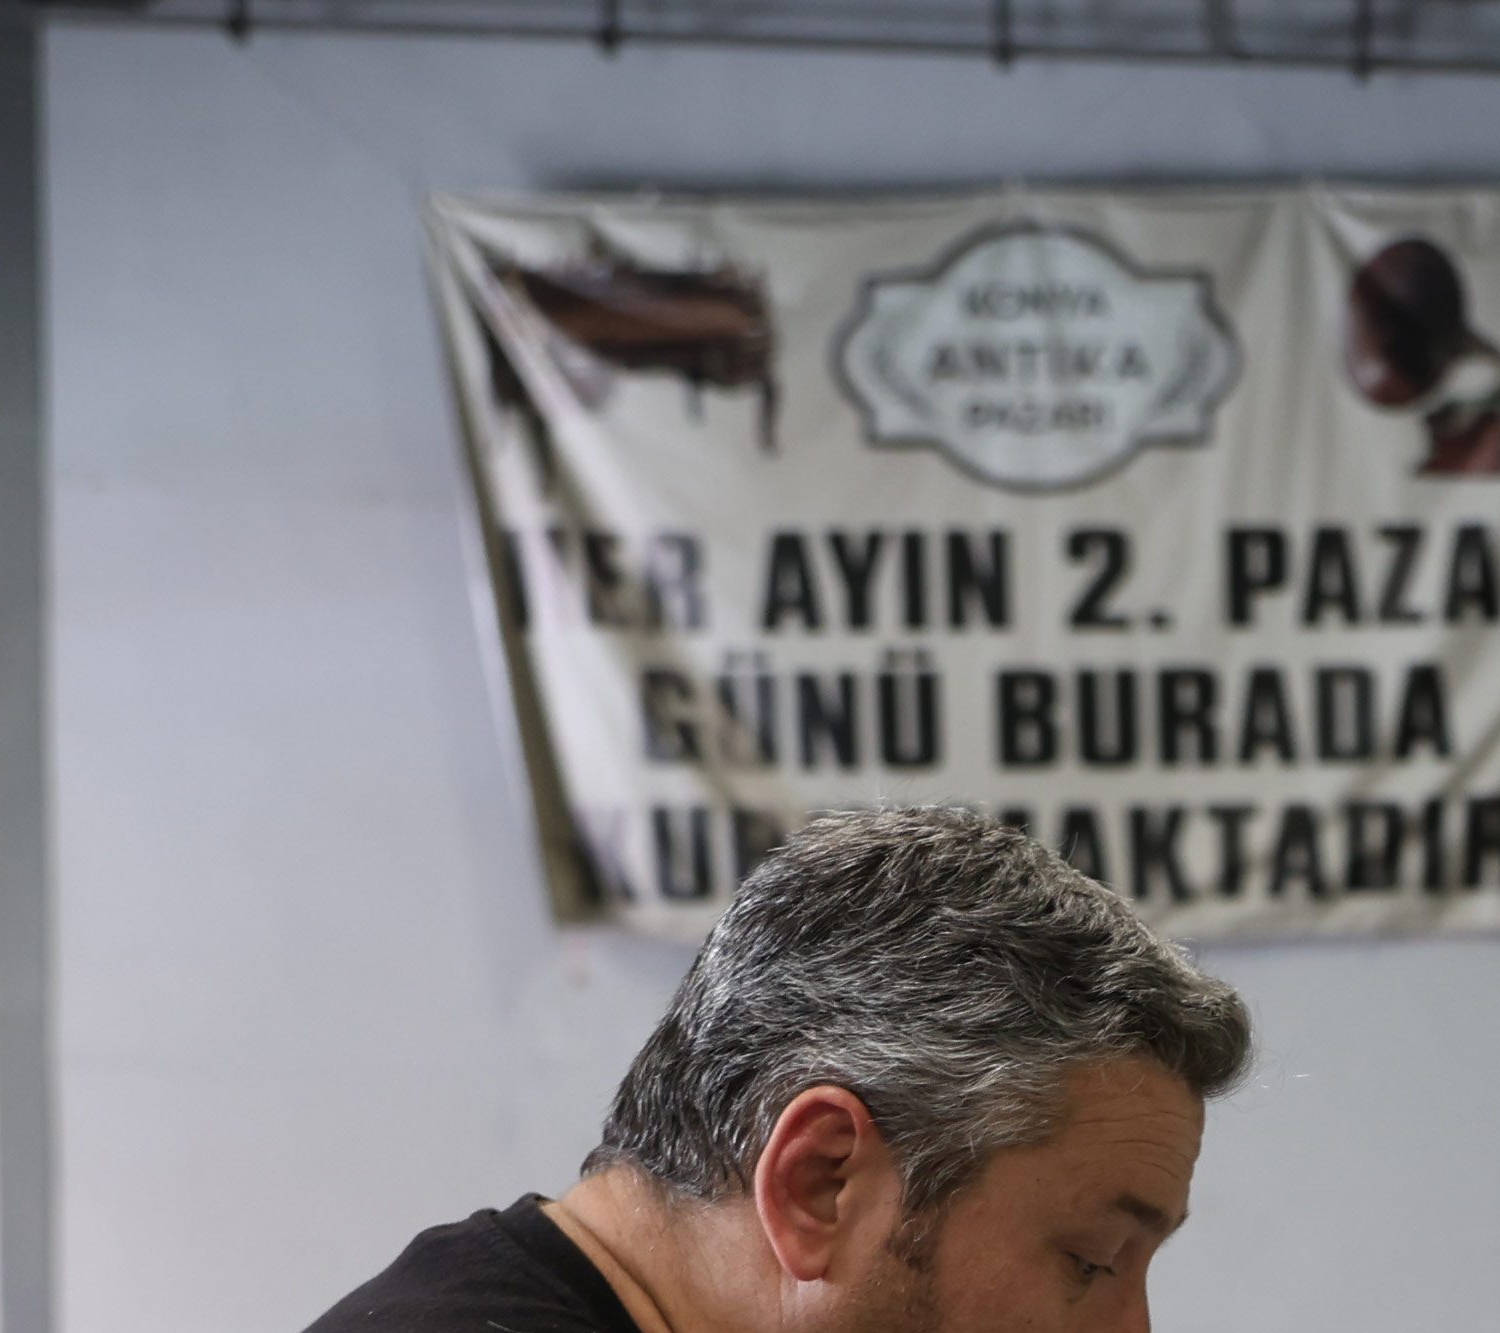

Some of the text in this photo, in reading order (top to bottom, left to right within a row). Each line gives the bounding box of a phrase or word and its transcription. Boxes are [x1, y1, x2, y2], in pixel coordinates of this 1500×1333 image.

[760, 528, 1014, 635] AYIN
[1065, 527, 1175, 635] 2.
[642, 648, 1456, 769] GÜNÜ BURADA
